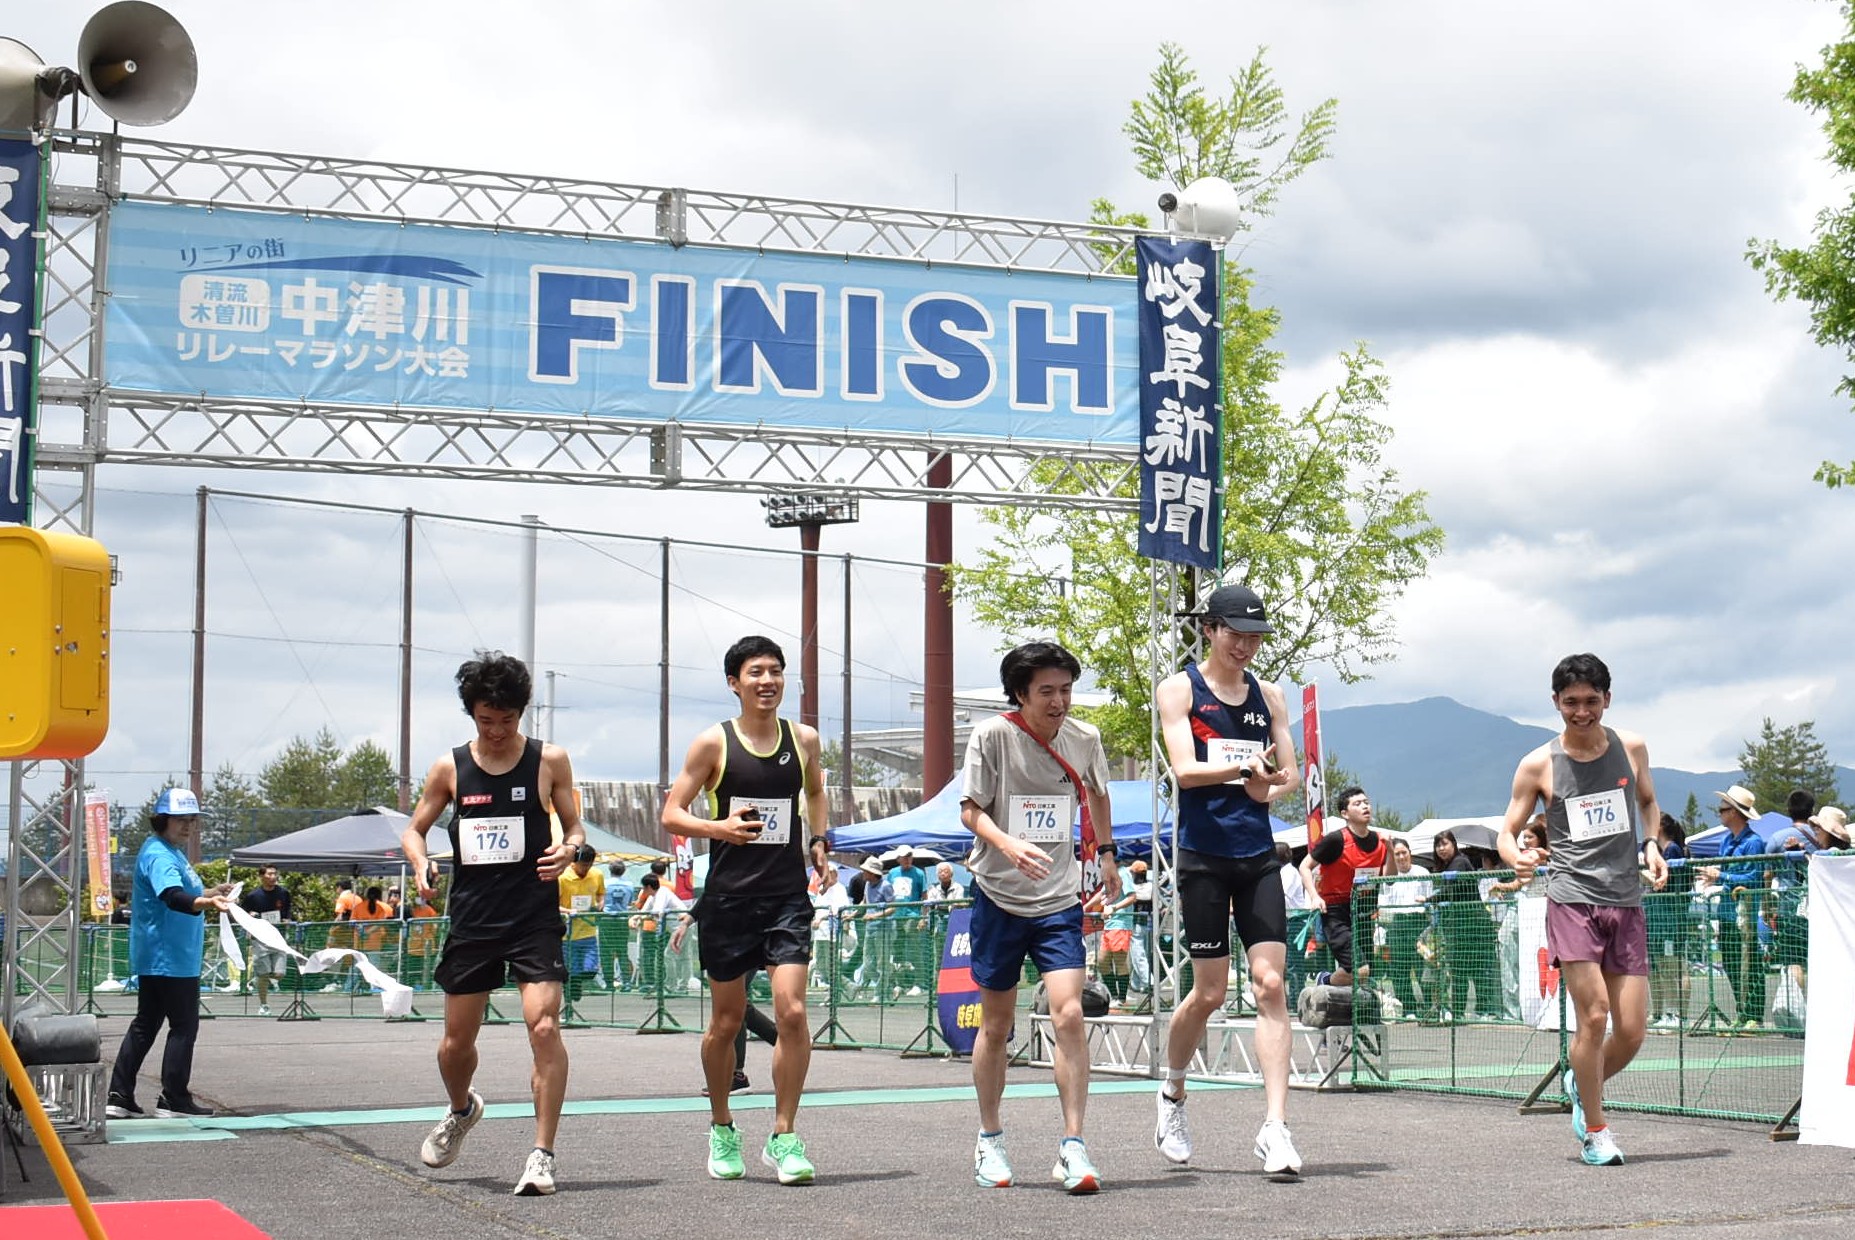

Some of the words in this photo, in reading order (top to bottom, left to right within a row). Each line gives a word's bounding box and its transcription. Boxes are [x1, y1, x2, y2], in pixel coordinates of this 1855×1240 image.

[180, 237, 285, 267] リニアの街
[203, 280, 248, 302] 清流
[190, 303, 259, 326] 木曽川
[281, 277, 469, 346] 中津川
[530, 265, 1113, 413] FINISH
[176, 332, 470, 378] リレーマラソン大会
[1143, 256, 1214, 552] 岐阜新聞
[1243, 711, 1267, 727] 刈谷
[1025, 811, 1056, 828] 176
[1584, 805, 1615, 826] 176
[476, 832, 510, 850] 176
[1190, 941, 1221, 949] 2XU
